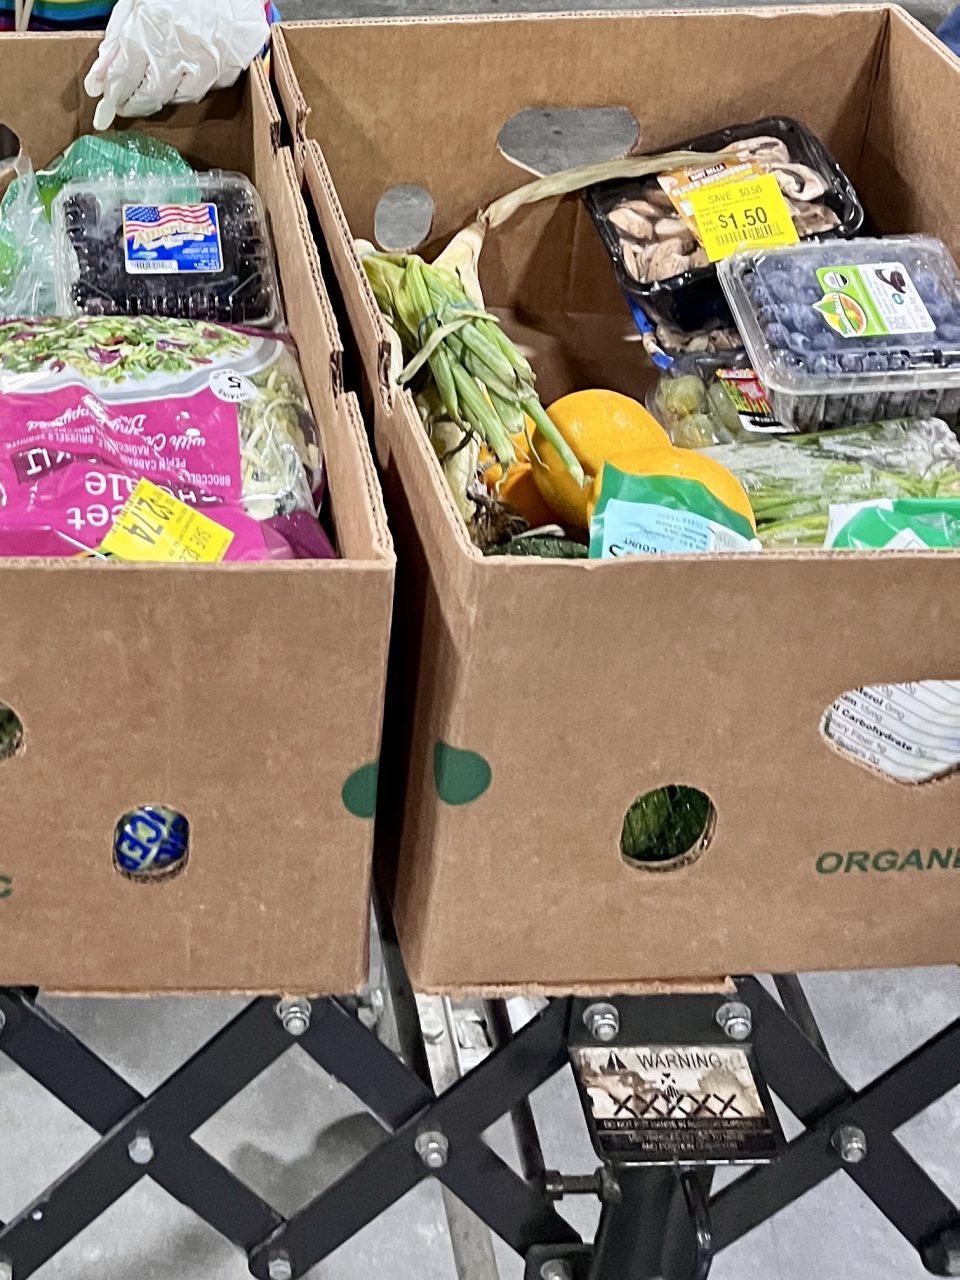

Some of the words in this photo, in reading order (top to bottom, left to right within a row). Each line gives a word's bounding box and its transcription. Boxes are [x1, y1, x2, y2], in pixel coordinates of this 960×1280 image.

[708, 191, 733, 204] SAVE
[718, 206, 768, 230] $1.50
[227, 375, 241, 389] 5
[170, 434, 207, 451] with
[623, 537, 657, 555] COUNT
[841, 708, 913, 751] Carbohydrate
